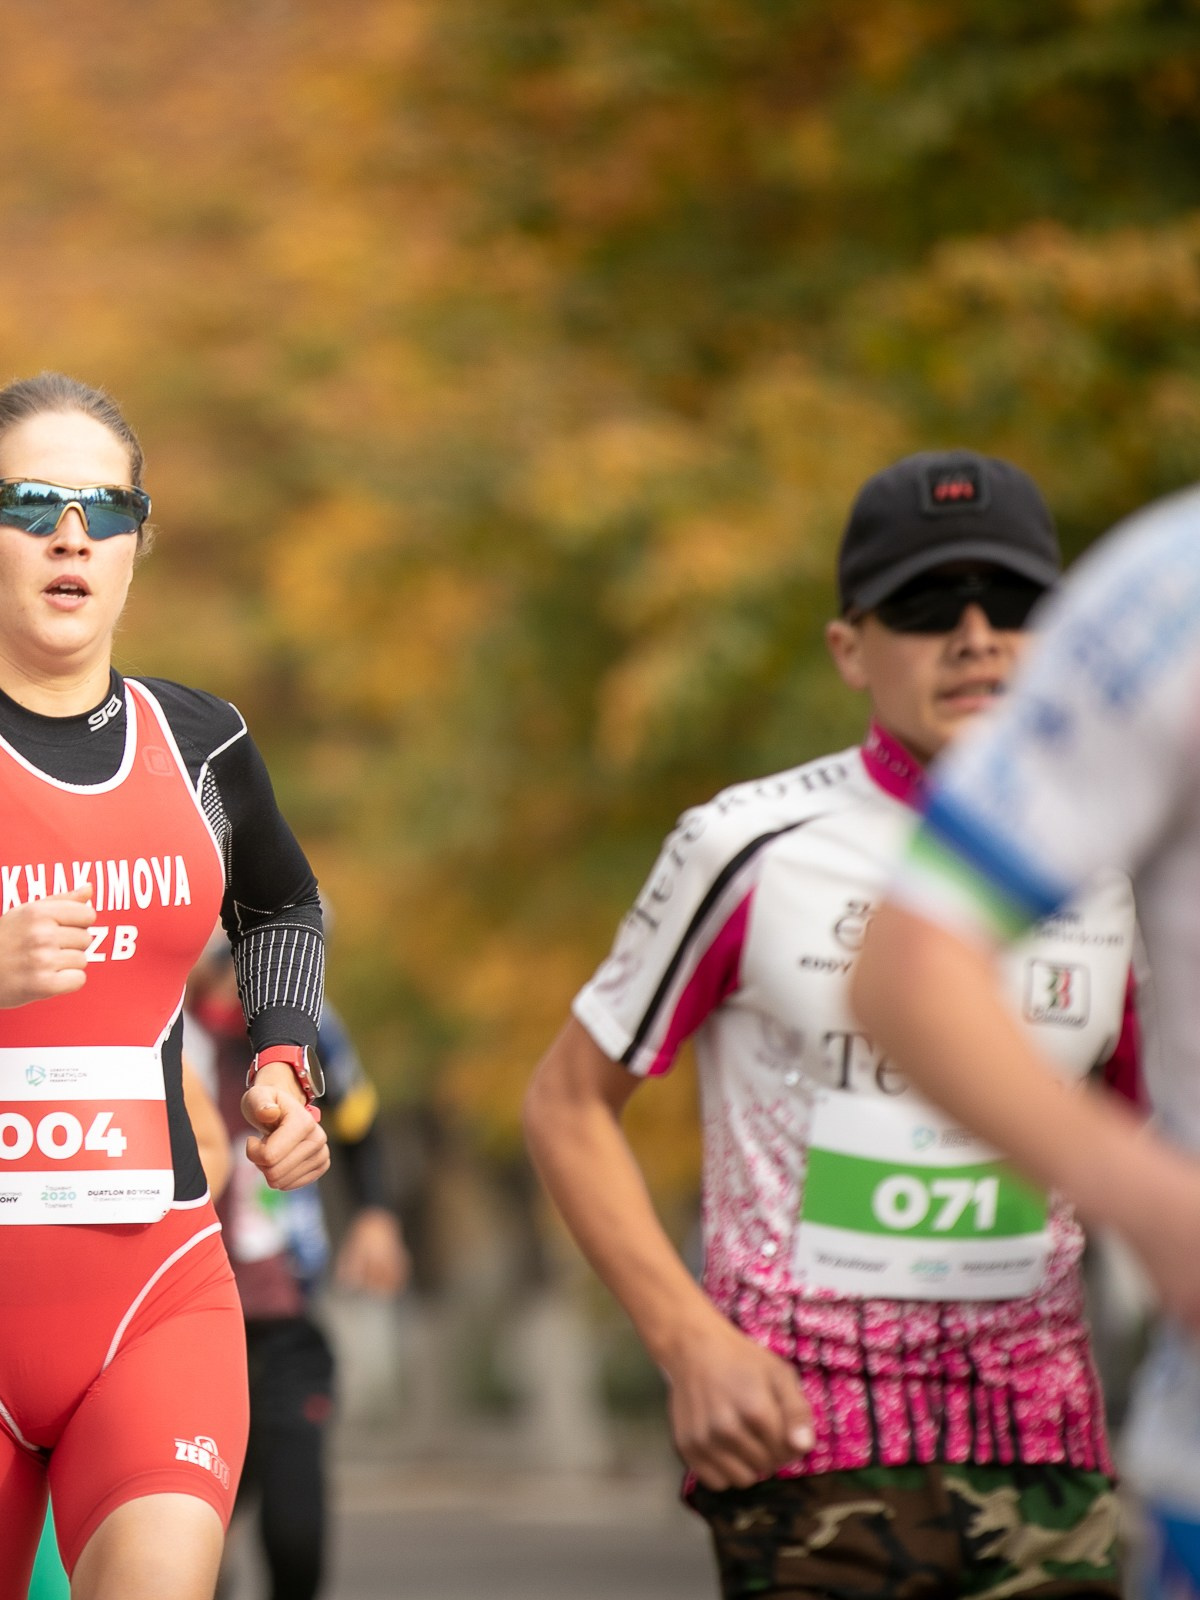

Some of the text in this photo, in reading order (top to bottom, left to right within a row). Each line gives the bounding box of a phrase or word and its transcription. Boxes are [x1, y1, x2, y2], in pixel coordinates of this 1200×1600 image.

[0, 854, 191, 916] KHAKIMOVA
[85, 925, 138, 963] ZB
[41, 1191, 77, 1201] 2020
[87, 1189, 124, 1197] DUATLON
[871, 1173, 1000, 1231] 071
